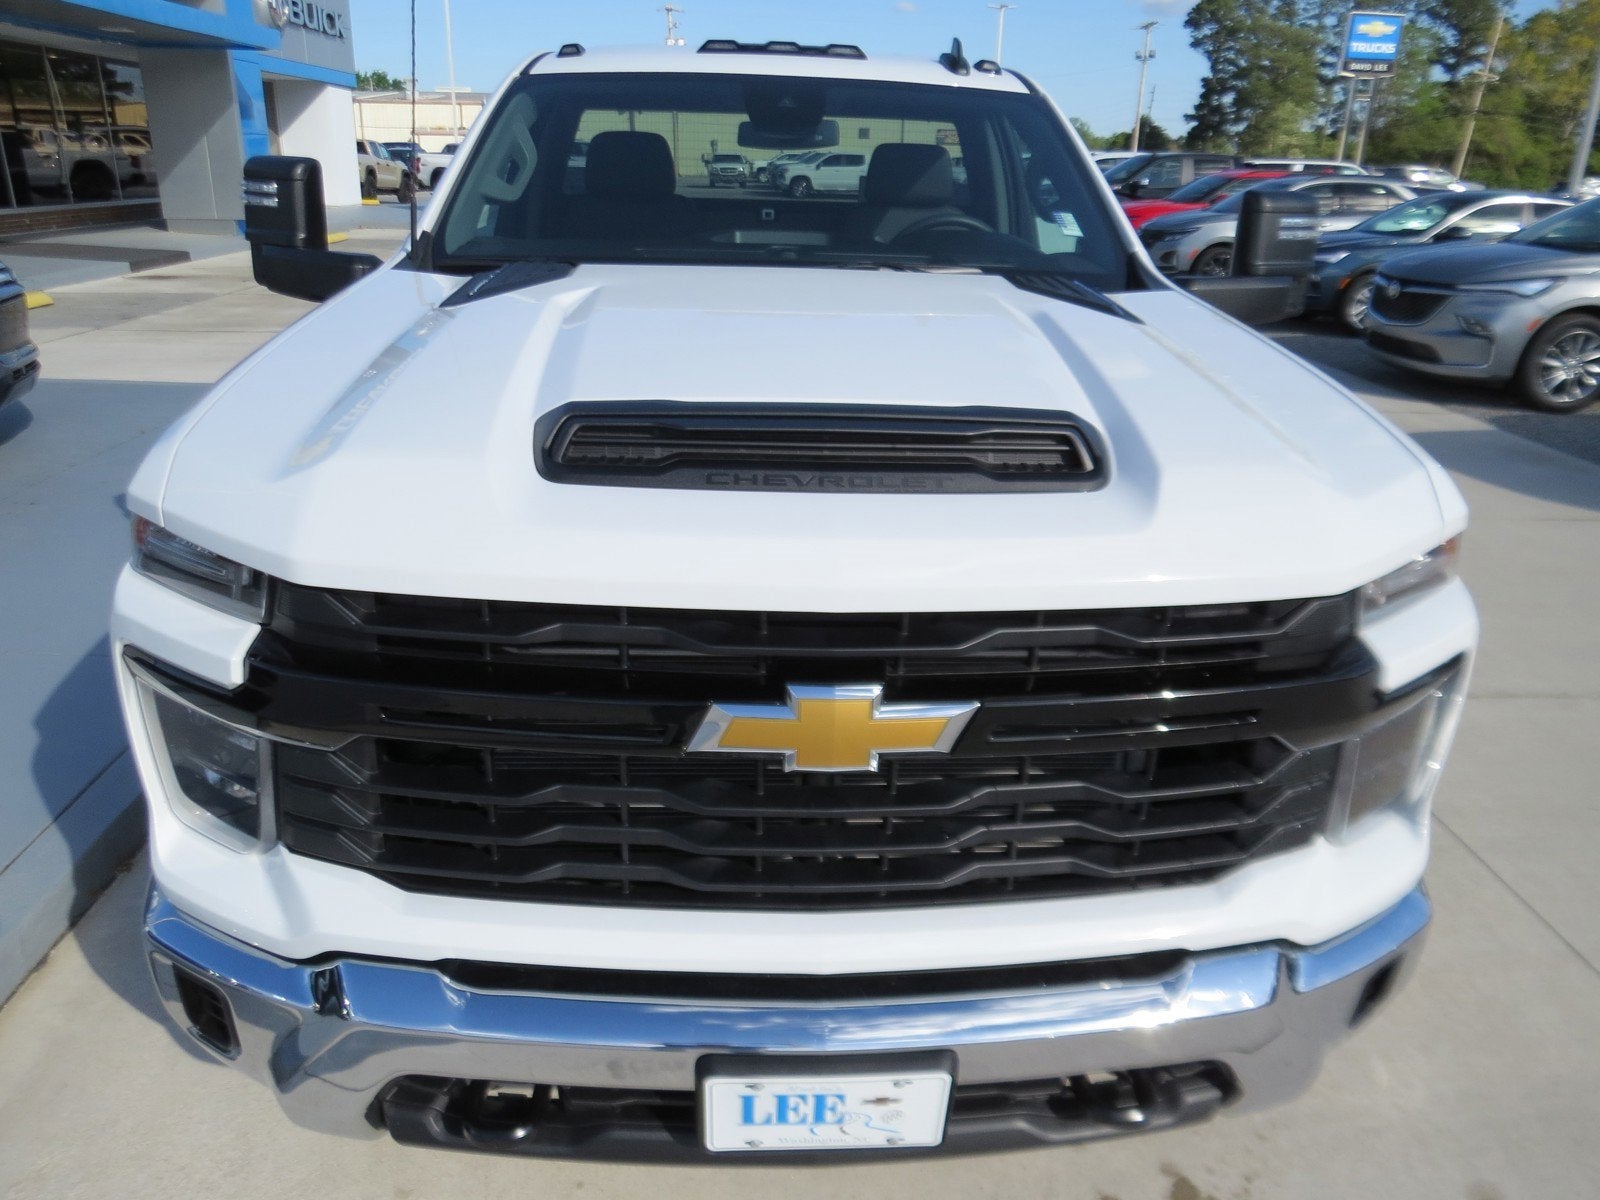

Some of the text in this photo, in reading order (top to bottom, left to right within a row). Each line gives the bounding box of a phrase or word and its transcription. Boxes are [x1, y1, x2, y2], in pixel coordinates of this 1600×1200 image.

[289, 0, 344, 38] BUICK
[1351, 42, 1397, 53] TRUCKS
[1351, 63, 1389, 72] DAVID LEE
[705, 472, 953, 489] CHEVROLET
[738, 1094, 847, 1126] LEE
